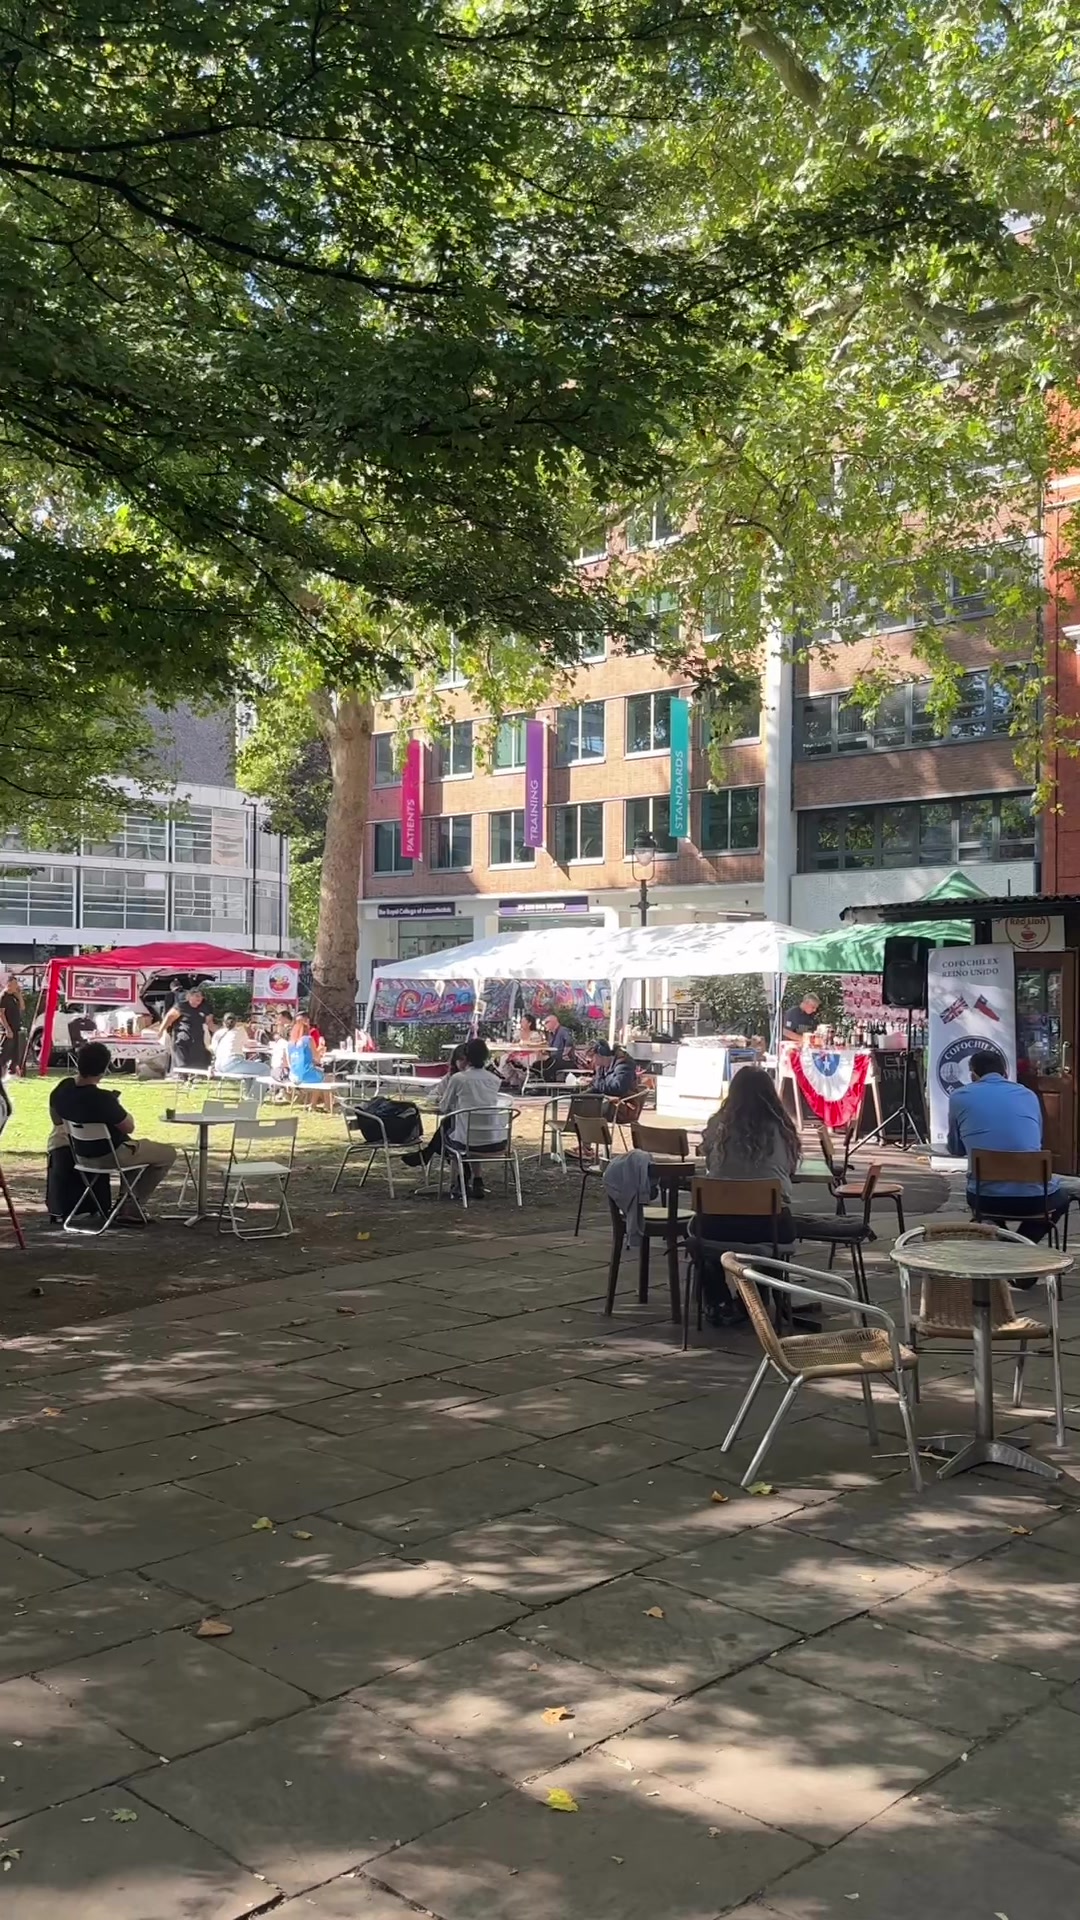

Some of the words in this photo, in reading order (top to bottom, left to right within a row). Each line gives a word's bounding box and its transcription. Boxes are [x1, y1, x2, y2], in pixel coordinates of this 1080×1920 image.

[530, 779, 539, 841] TRAINING
[675, 750, 684, 830] STANDARDS
[406, 798, 415, 852] PATIENTS
[942, 970, 969, 978] REINO
[970, 967, 999, 976] UNIDO
